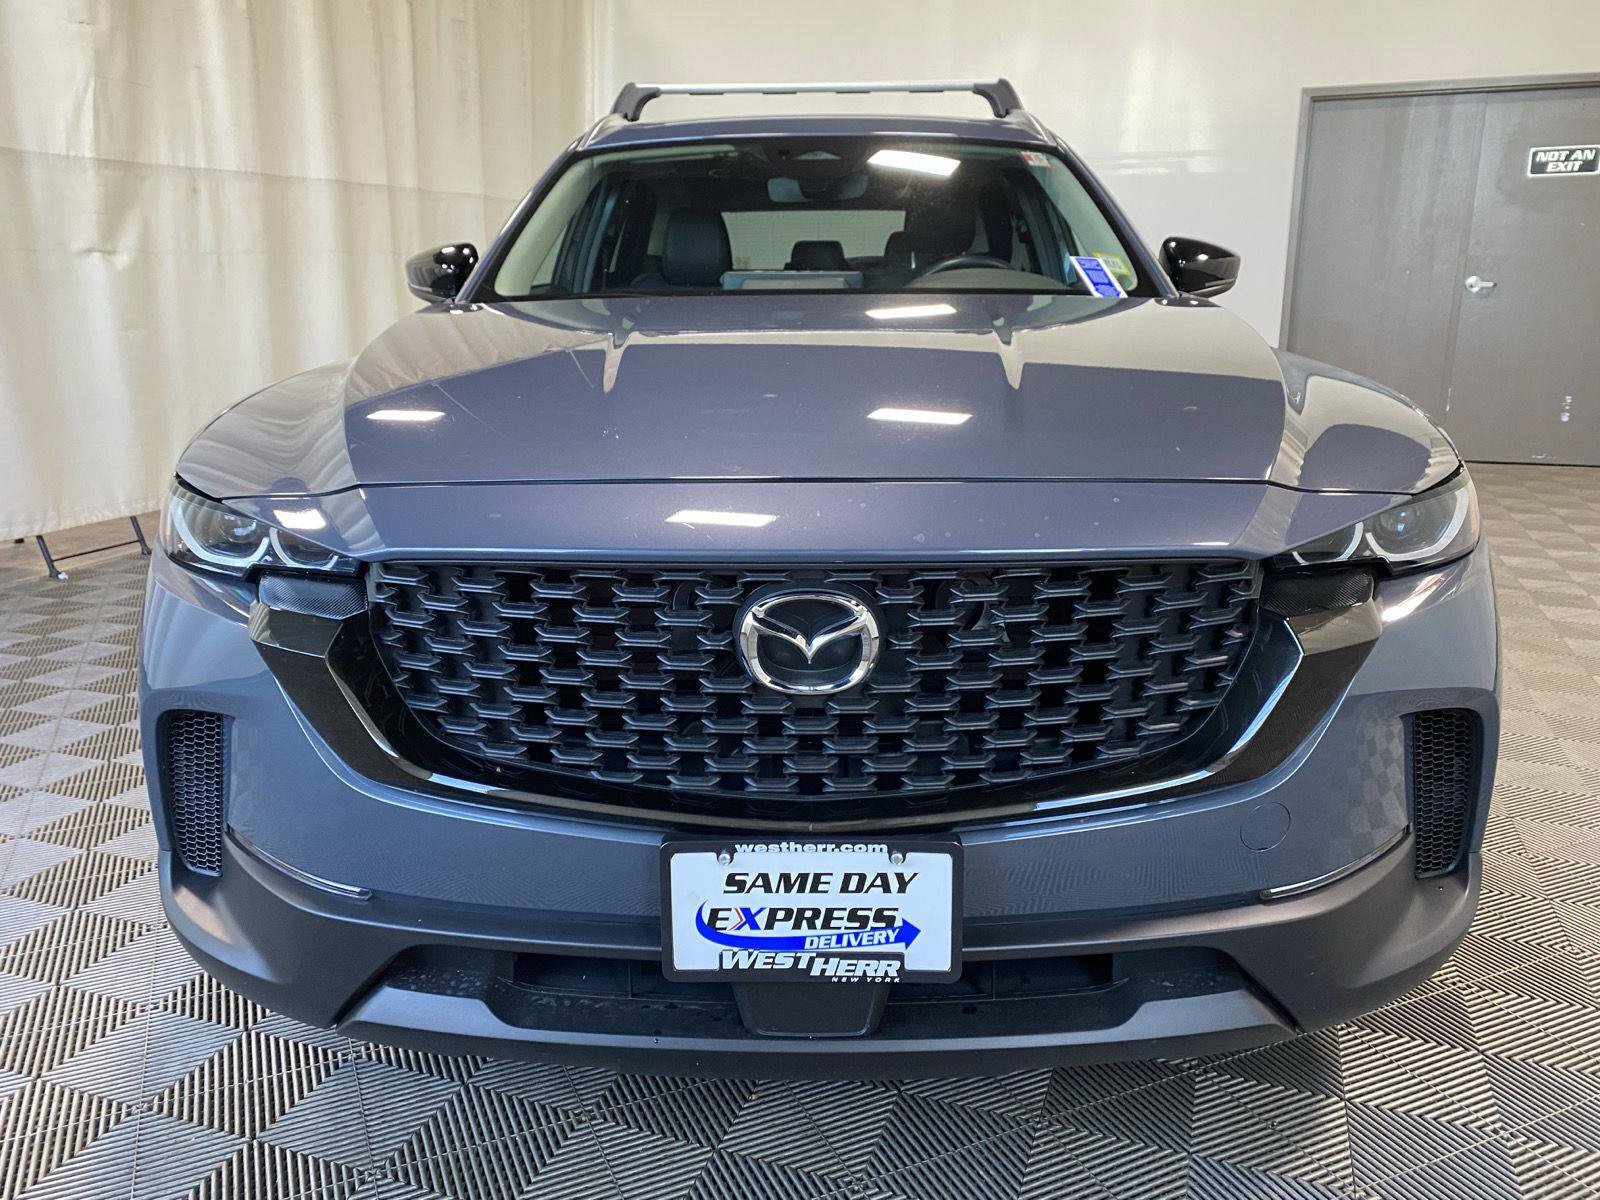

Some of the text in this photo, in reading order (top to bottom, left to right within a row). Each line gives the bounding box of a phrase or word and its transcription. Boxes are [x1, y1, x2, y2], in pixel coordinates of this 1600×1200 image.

[1536, 149, 1596, 162] NOT AN
[1546, 161, 1583, 172] EXIT
[735, 842, 888, 853] westherr.com
[723, 872, 918, 894] SAME DAY
[707, 907, 899, 931] EXPRESS
[804, 929, 899, 950] DELIVERY
